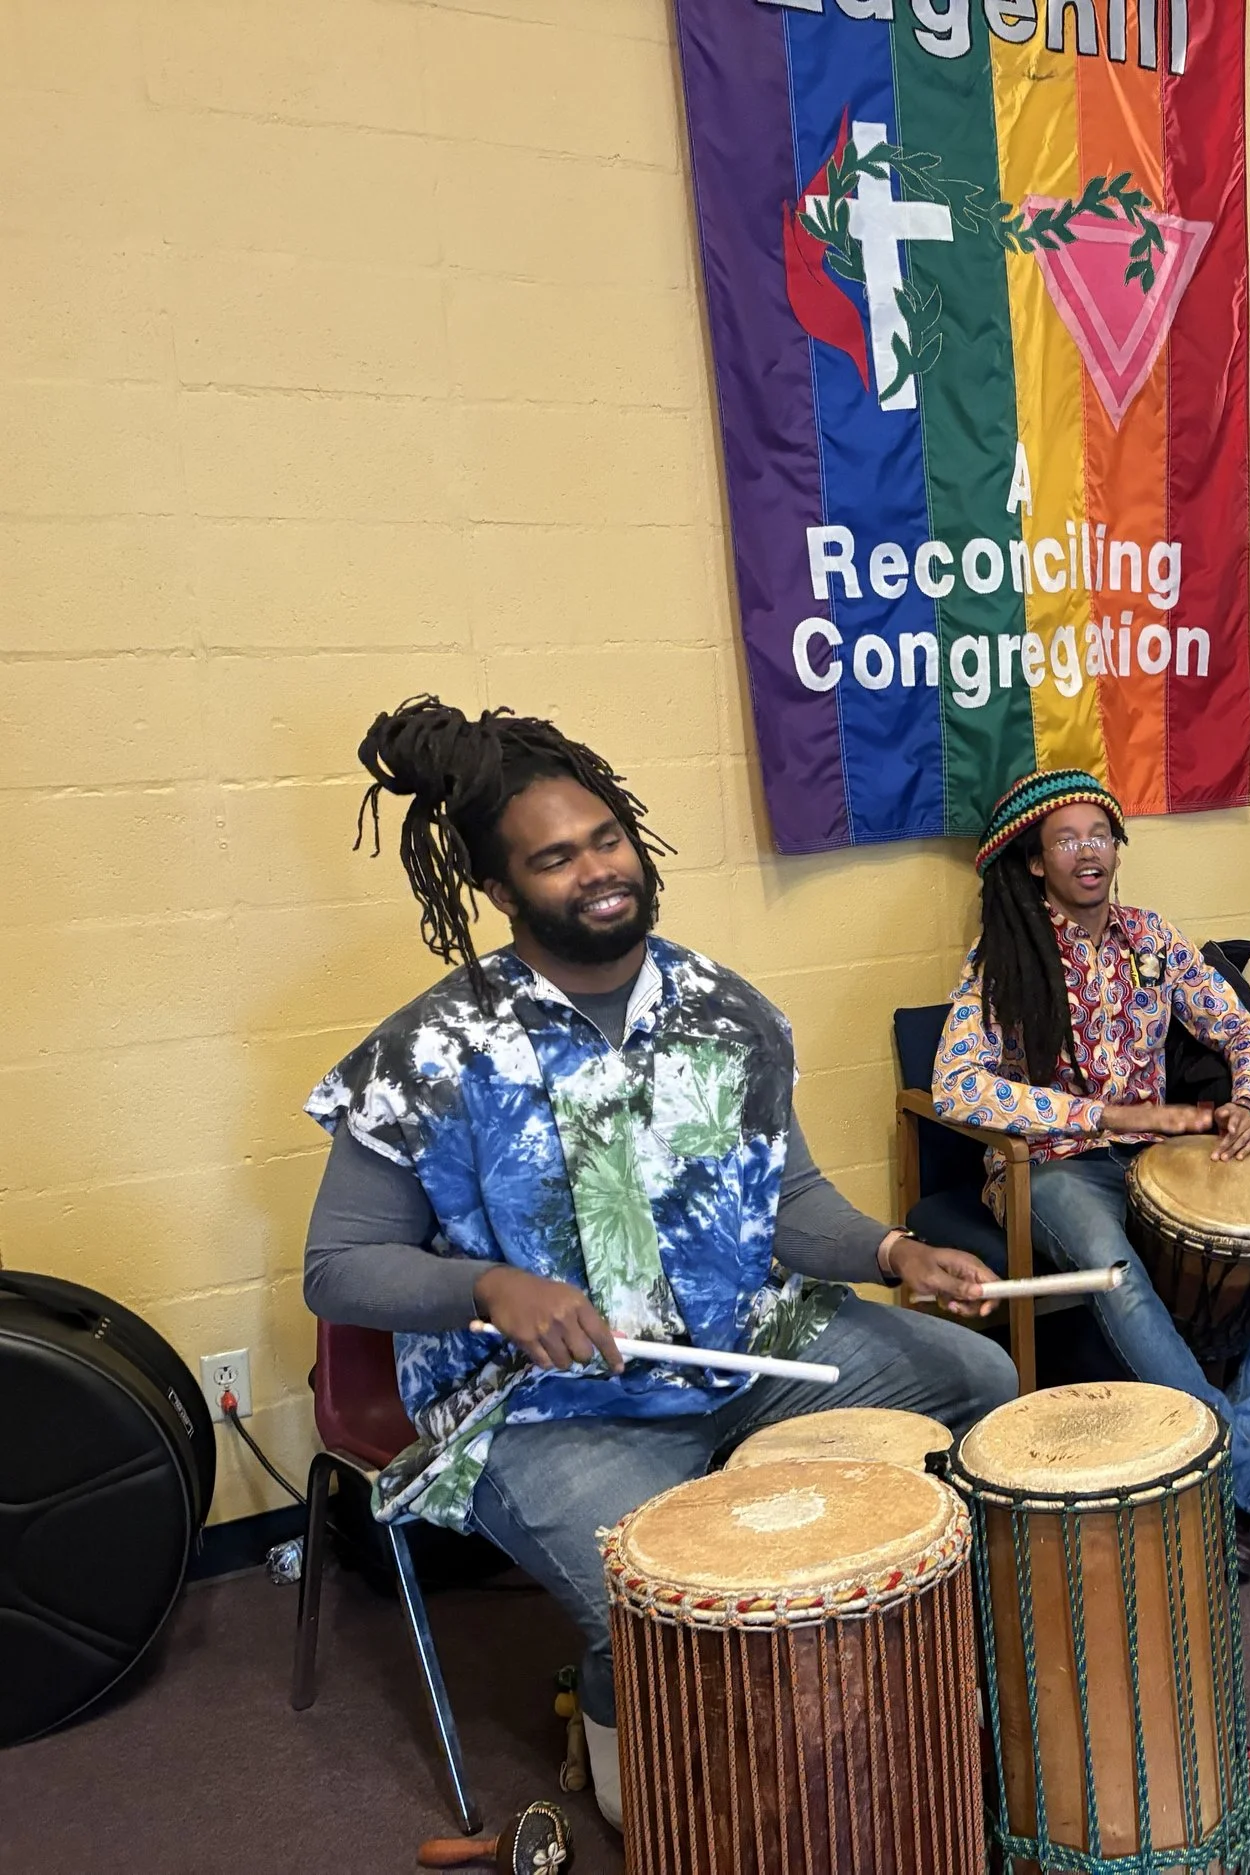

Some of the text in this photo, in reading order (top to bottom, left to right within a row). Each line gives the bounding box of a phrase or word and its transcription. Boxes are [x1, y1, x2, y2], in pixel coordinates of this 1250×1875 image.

[1006, 442, 1033, 515] A
[806, 519, 1182, 610] Reconciling
[792, 610, 1210, 709] Congregation
